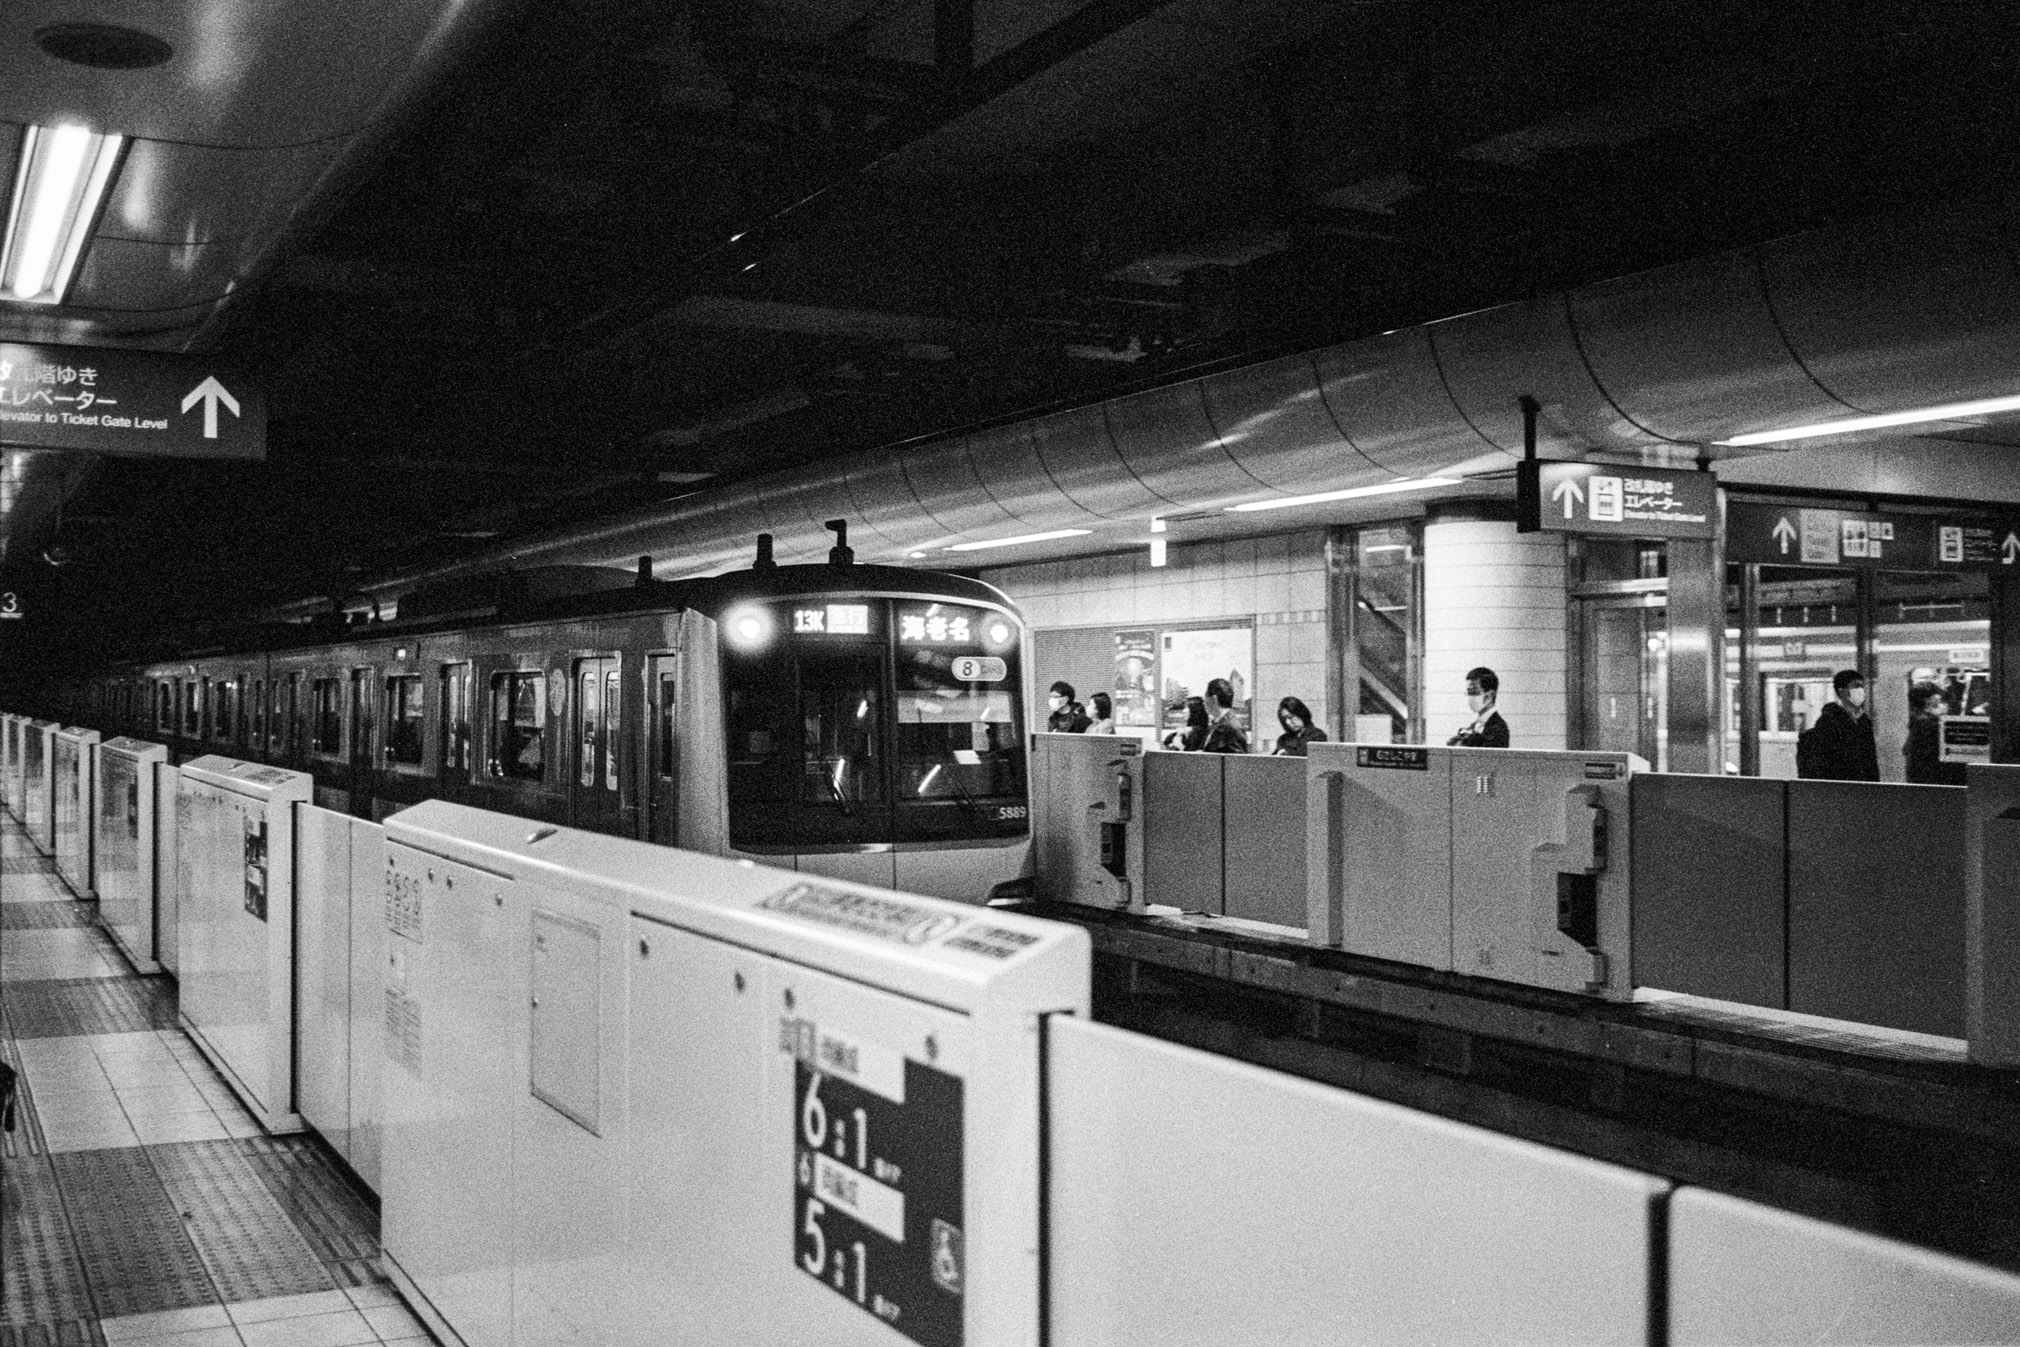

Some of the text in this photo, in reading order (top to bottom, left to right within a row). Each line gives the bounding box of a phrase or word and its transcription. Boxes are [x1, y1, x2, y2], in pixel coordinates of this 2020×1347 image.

[45, 412, 58, 423] to
[61, 413, 98, 426] Ticket
[101, 415, 132, 427] Gate
[134, 417, 168, 430] Level
[1624, 495, 1683, 510] エレベーター
[2, 592, 17, 612] 3
[794, 609, 825, 631] 13K
[901, 615, 970, 641] 海老名
[962, 661, 974, 677] 8
